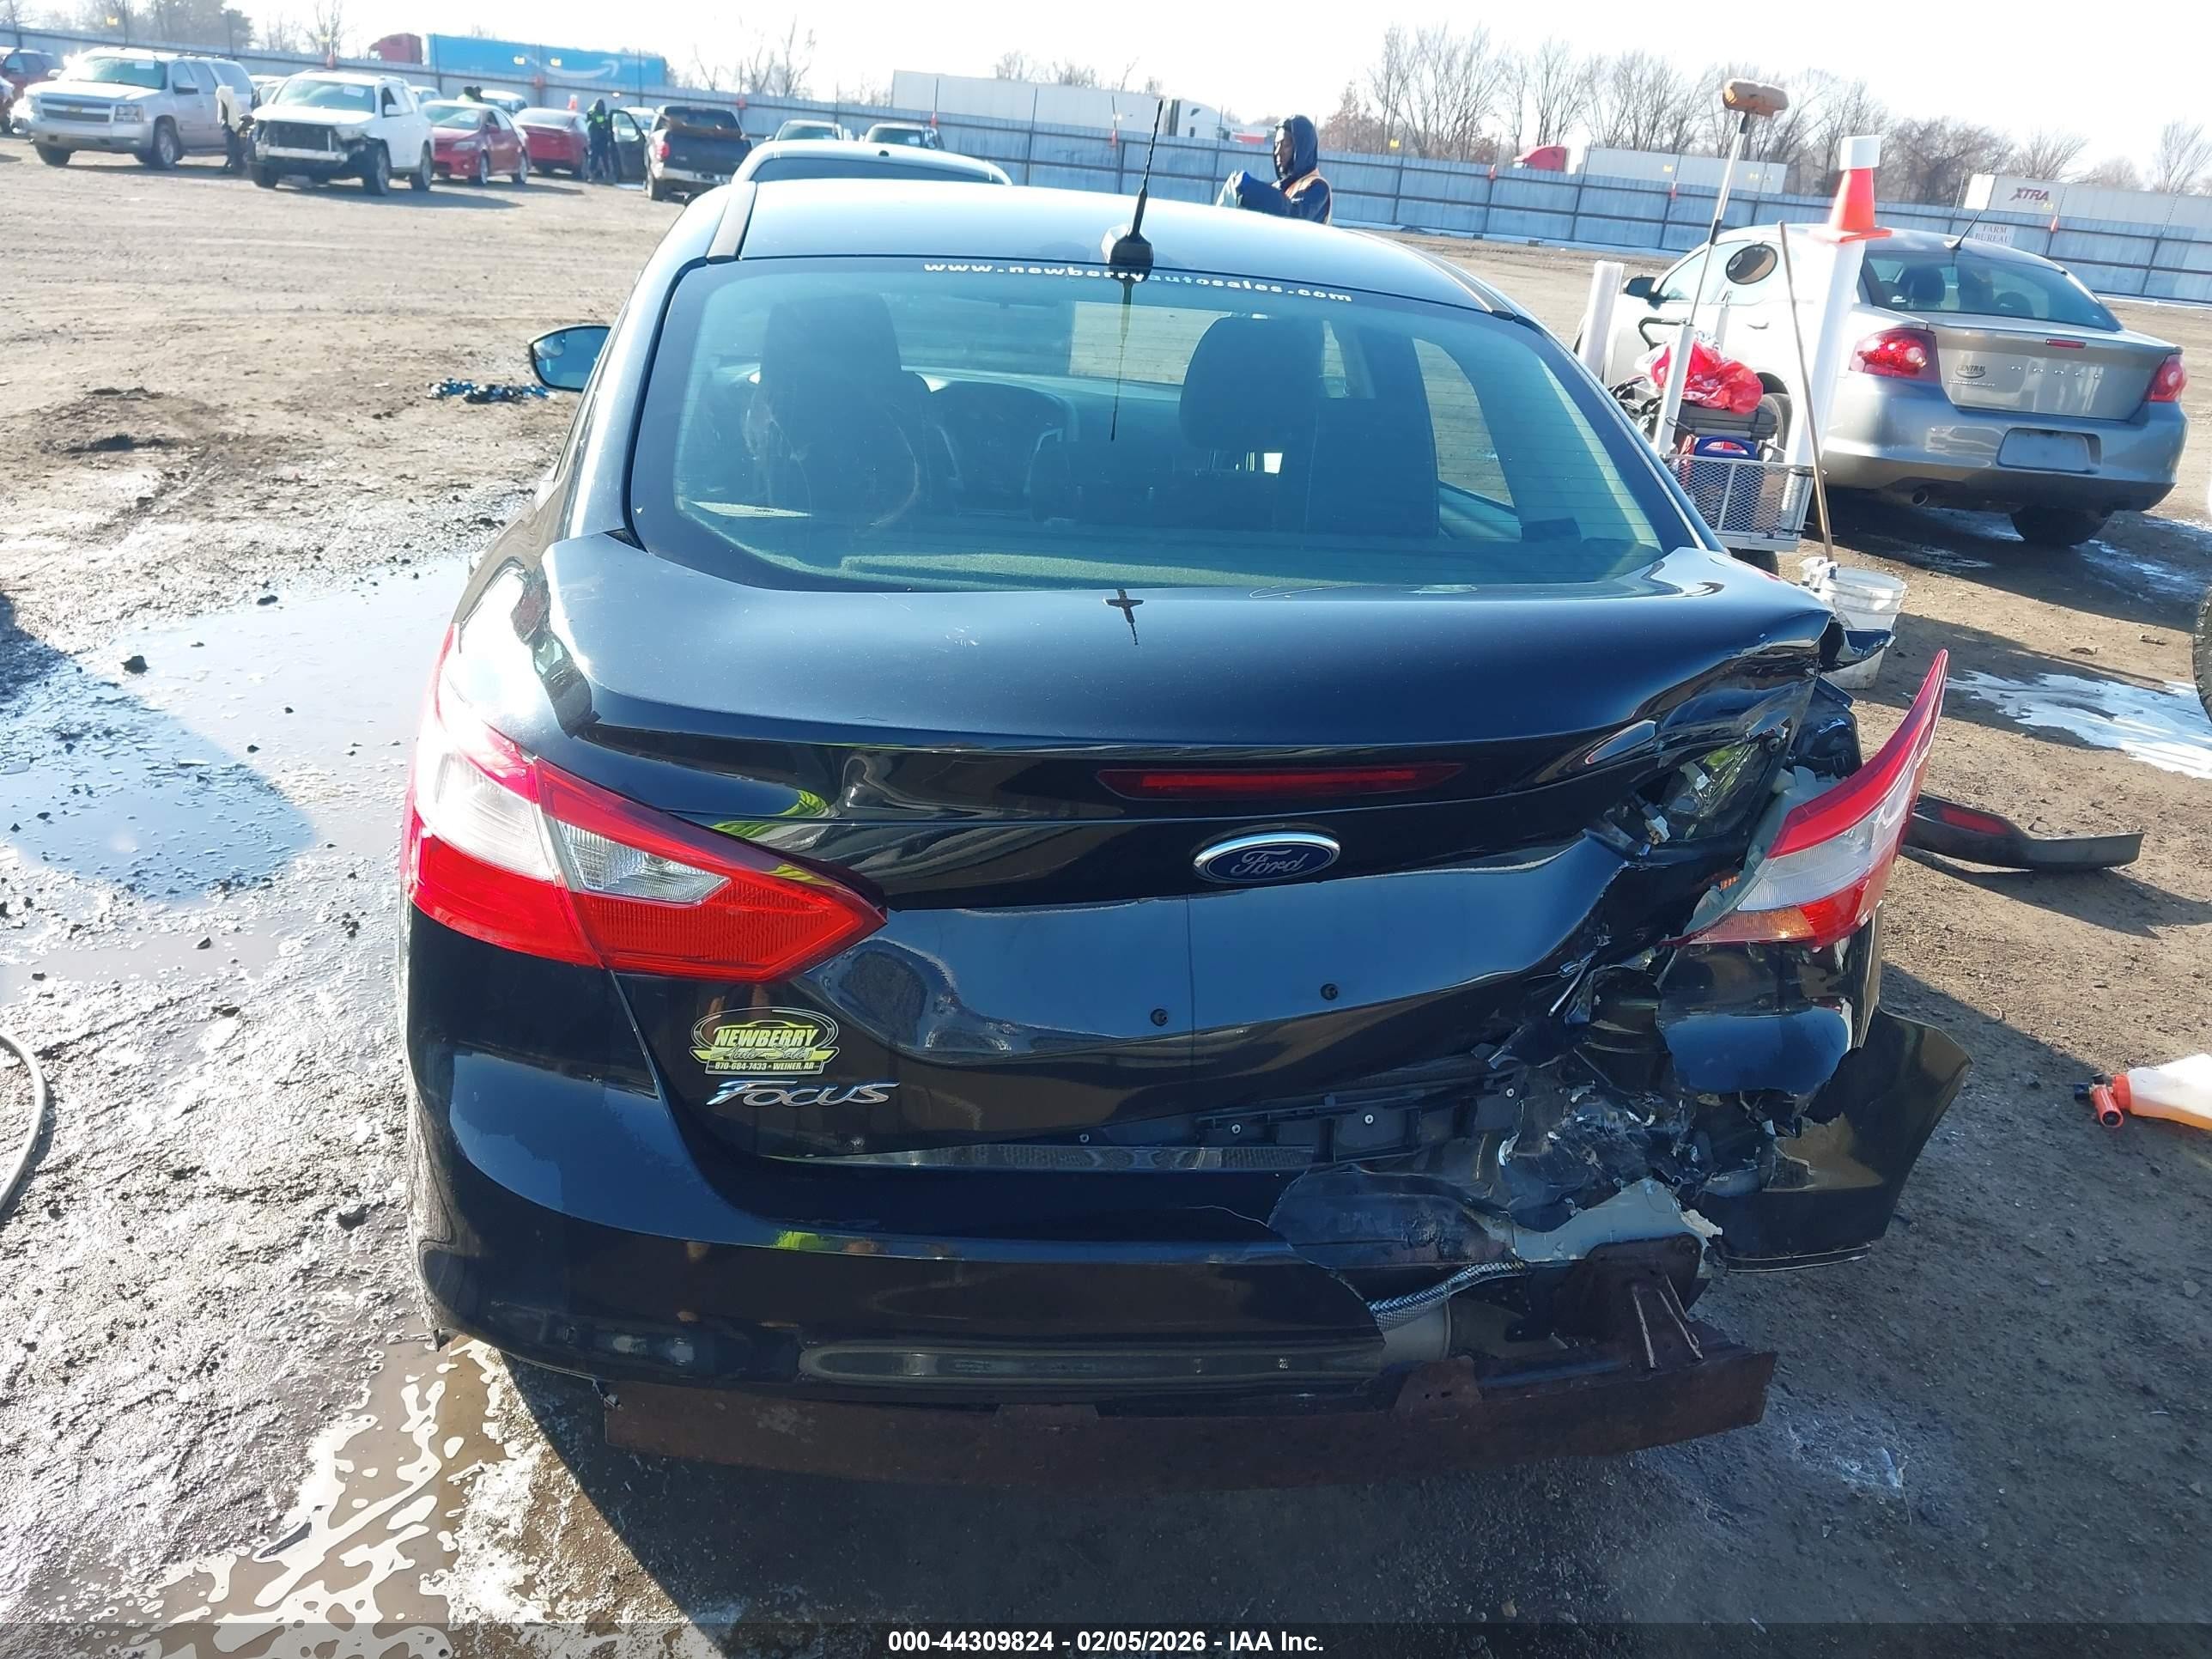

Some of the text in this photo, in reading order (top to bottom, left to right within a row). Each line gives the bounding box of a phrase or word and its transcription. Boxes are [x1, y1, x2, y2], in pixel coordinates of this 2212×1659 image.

[2008, 186, 2050, 202] XTRA
[1982, 225, 2008, 234] FARM
[924, 262, 1353, 303] www.newberryautosales.com
[1230, 848, 1310, 877] Ford
[714, 1028, 819, 1047] NEWBERRY
[710, 1043, 759, 1060] Auto
[714, 1062, 767, 1071] 870-684-7433
